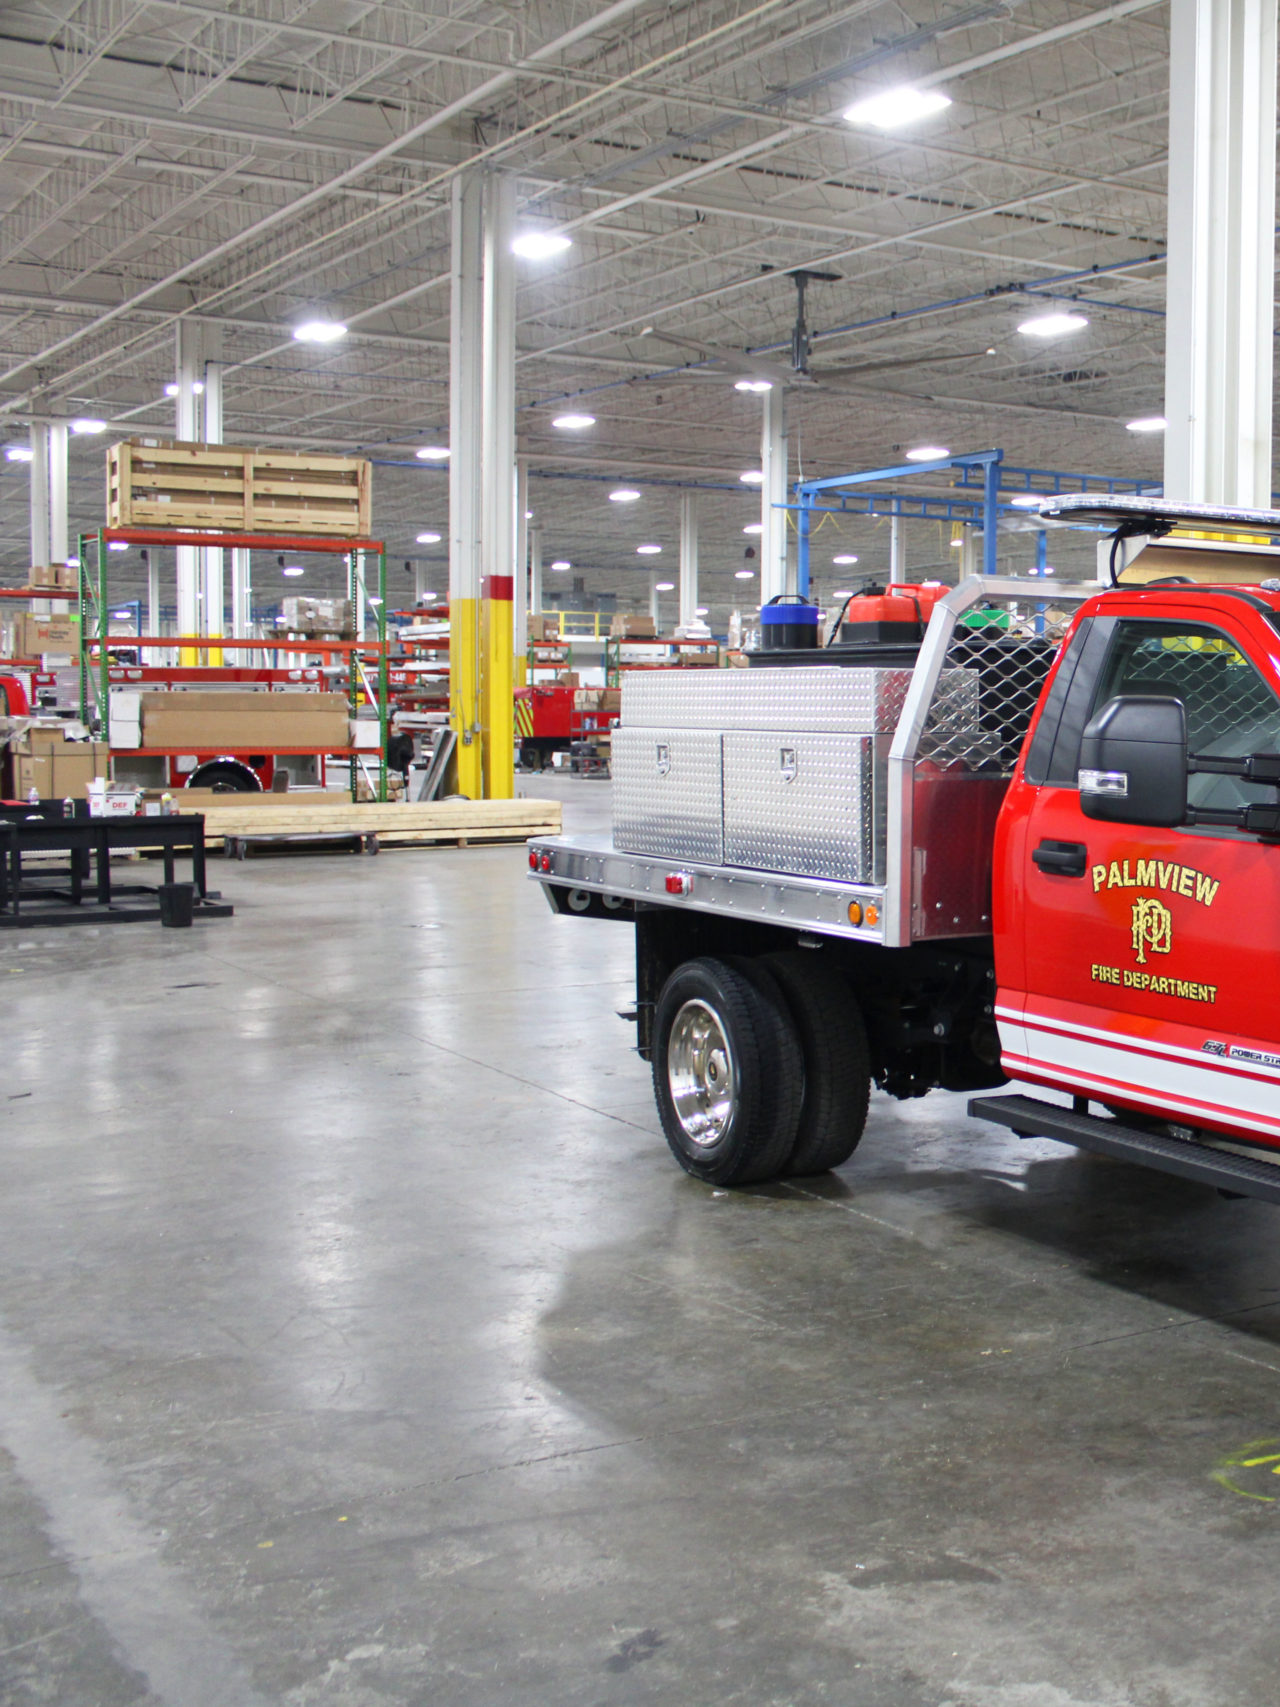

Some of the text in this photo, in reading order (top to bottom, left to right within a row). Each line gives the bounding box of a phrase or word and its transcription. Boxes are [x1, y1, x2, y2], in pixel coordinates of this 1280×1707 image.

[112, 801, 128, 809] DEF
[1092, 859, 1220, 907] PALMVIEW
[1091, 963, 1218, 1003] FIRE DEPARTMENT
[1231, 1048, 1262, 1060] POWER
